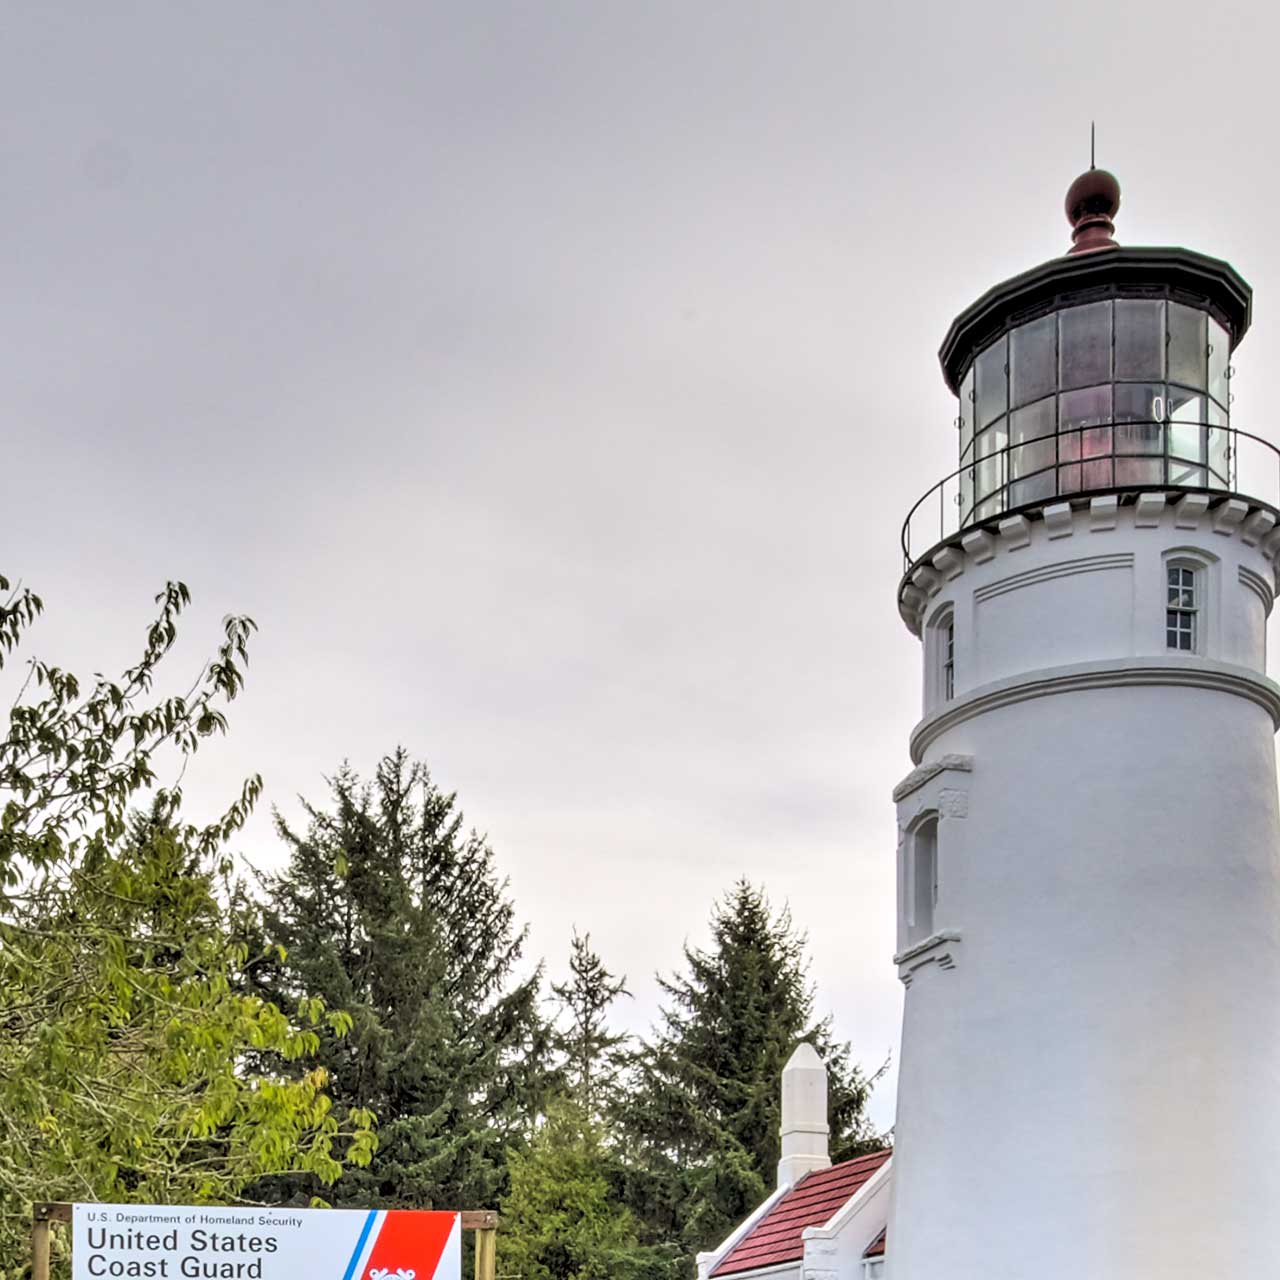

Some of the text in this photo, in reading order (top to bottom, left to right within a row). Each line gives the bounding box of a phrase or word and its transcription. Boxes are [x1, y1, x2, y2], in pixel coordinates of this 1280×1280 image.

[87, 1212, 303, 1228] U.S. Department of Homeland Security
[87, 1228, 278, 1252] United States
[87, 1254, 262, 1279] Coast Guard
